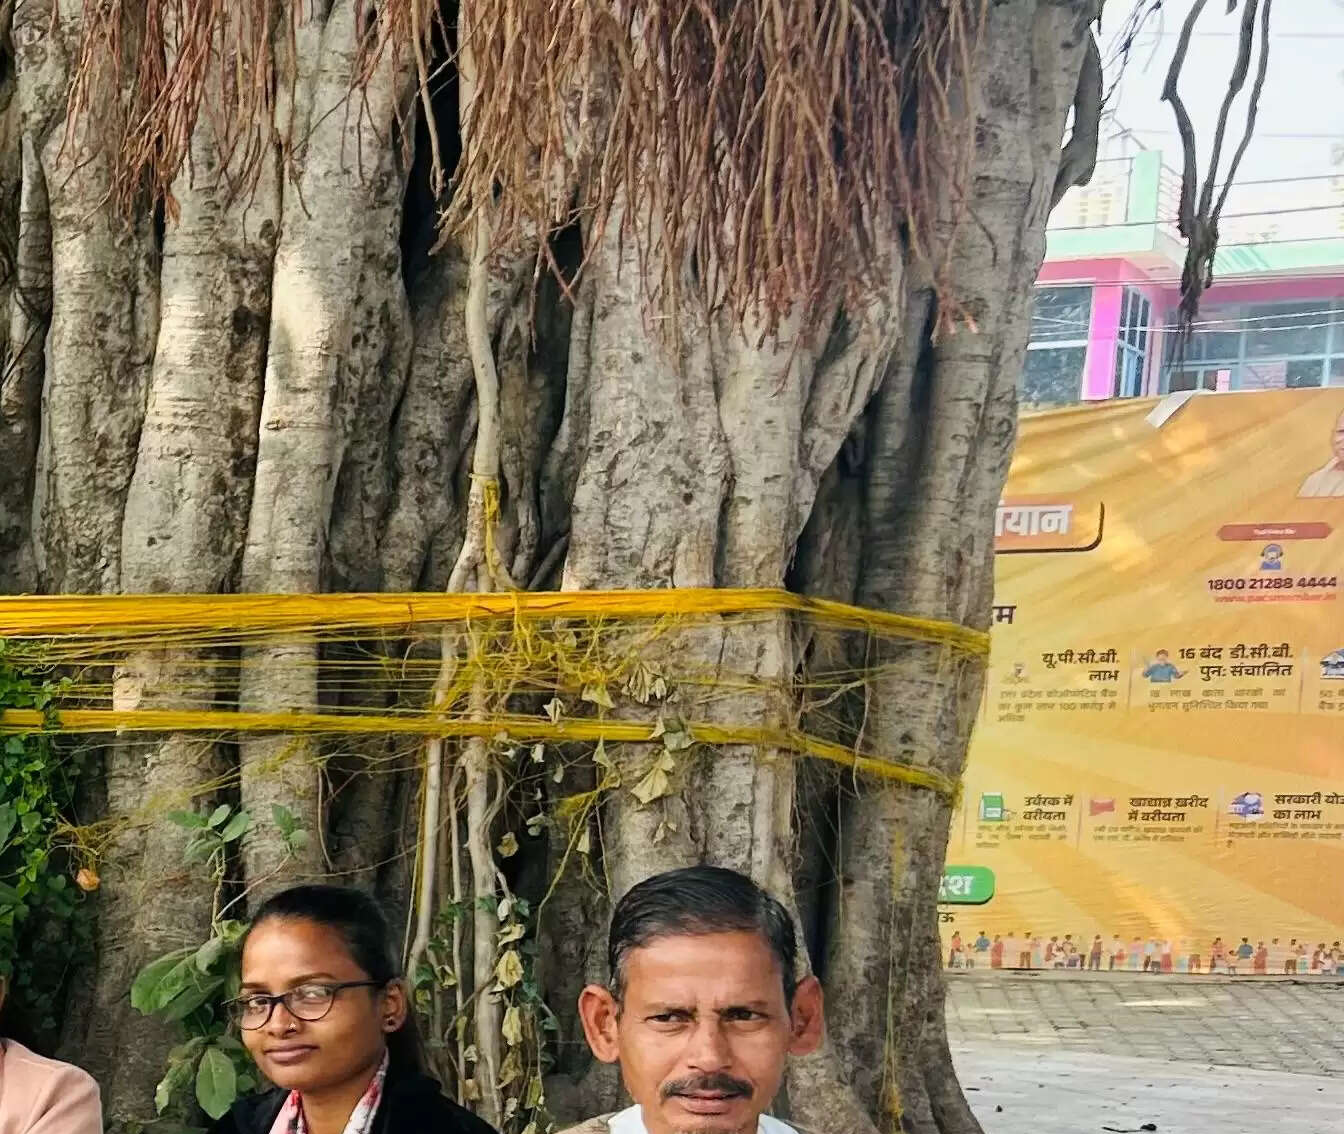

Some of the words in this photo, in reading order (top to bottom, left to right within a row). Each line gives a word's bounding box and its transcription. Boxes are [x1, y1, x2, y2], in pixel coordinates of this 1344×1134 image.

[1208, 578, 1245, 590] 1800
[1249, 577, 1294, 590] 21288
[1297, 576, 1337, 589] 4444
[1178, 647, 1195, 659] 16
[1230, 661, 1293, 678] संचालित
[1089, 670, 1120, 682] लाभ
[1275, 792, 1322, 805] सरकारी
[1273, 810, 1292, 820] का
[1294, 810, 1322, 820] लाभ
